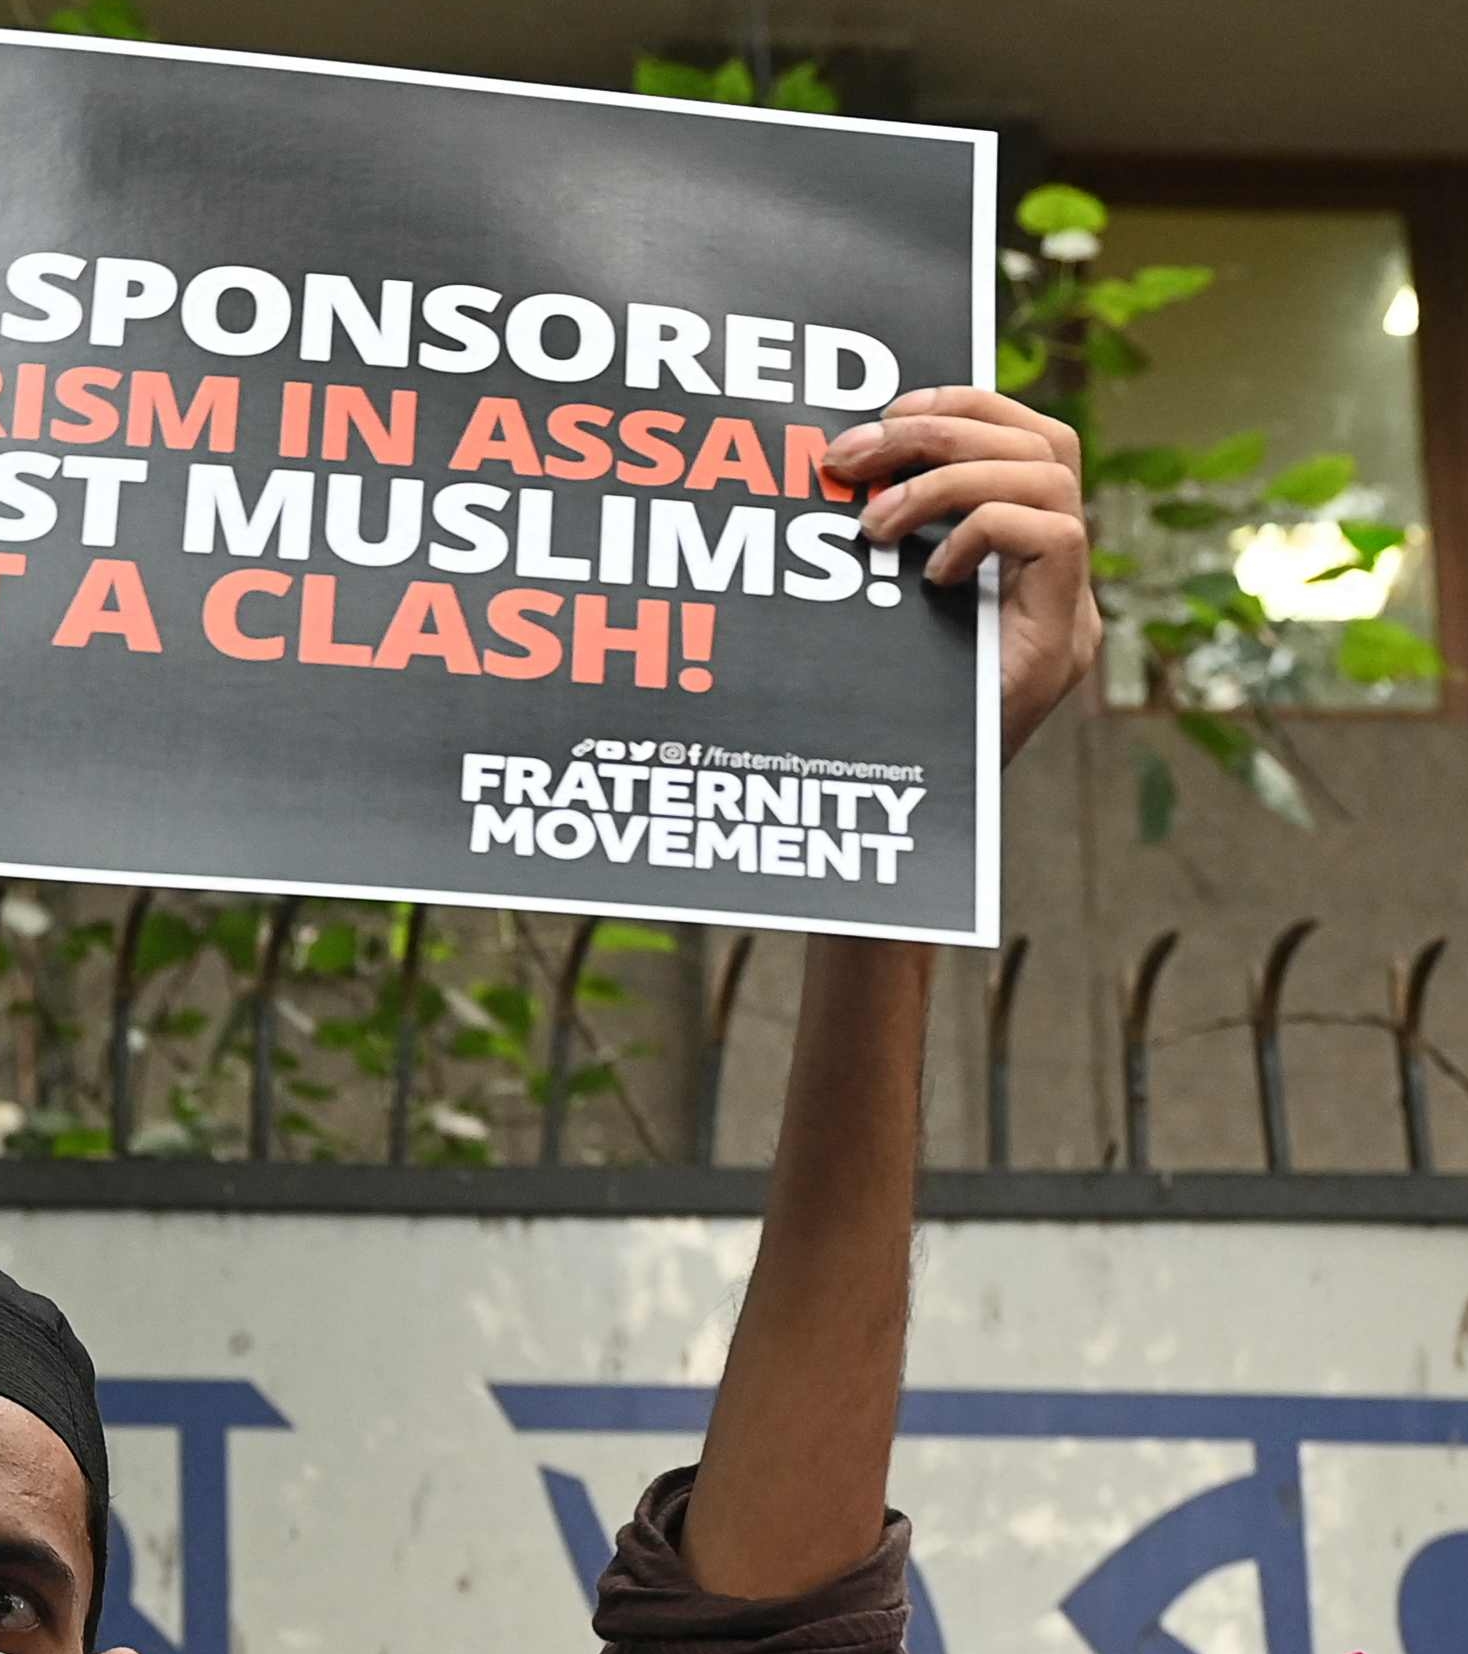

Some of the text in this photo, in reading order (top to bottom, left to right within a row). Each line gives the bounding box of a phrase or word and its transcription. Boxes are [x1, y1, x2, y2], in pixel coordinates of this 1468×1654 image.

[0, 252, 900, 411] SPONSORED
[278, 381, 418, 466] IN
[182, 464, 902, 608] MUSLIMS!
[51, 559, 162, 653] A
[202, 568, 717, 692] CLASH!
[462, 752, 926, 835] FRATERNITY
[469, 804, 914, 884] MOVEMENT
